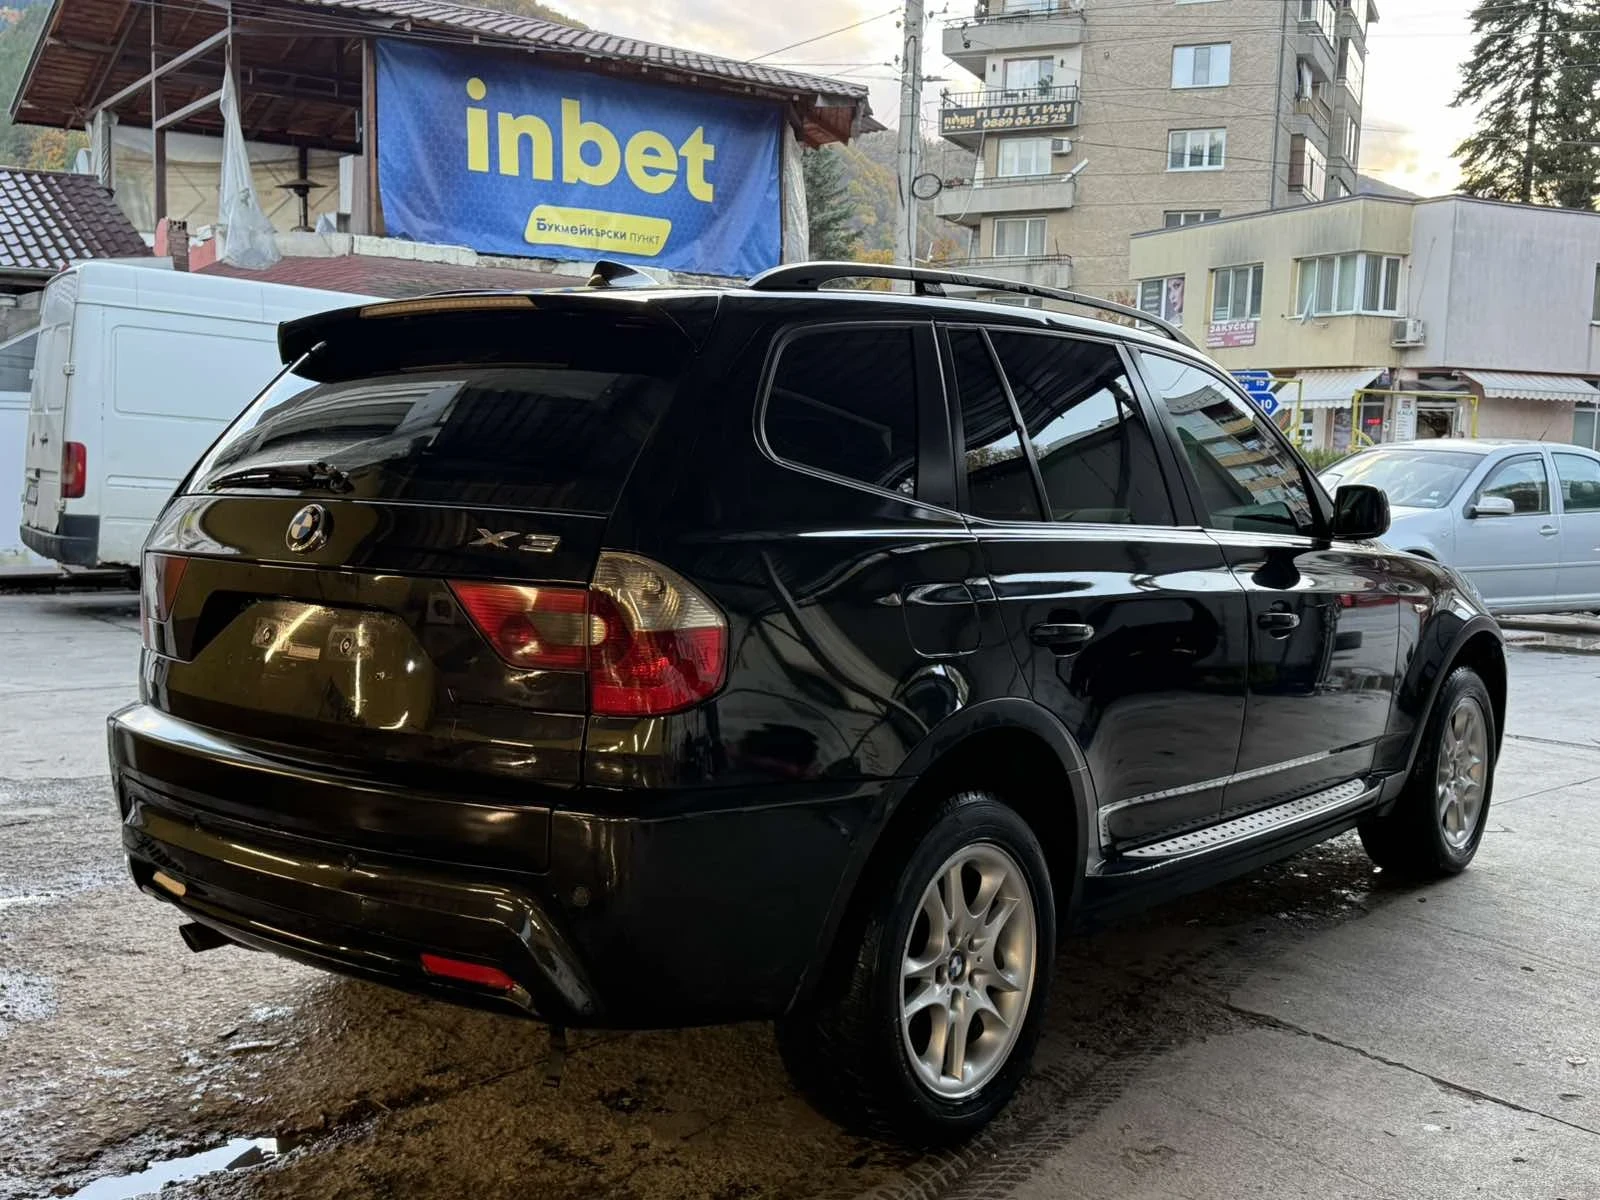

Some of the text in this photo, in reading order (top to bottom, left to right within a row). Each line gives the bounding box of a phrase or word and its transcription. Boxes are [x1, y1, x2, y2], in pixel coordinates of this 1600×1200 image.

[982, 117, 1013, 128] 0889
[466, 77, 715, 203] inbet
[1209, 321, 1255, 333] ЗАКУСКИ
[1261, 399, 1273, 410] 10
[468, 528, 561, 553] X3
